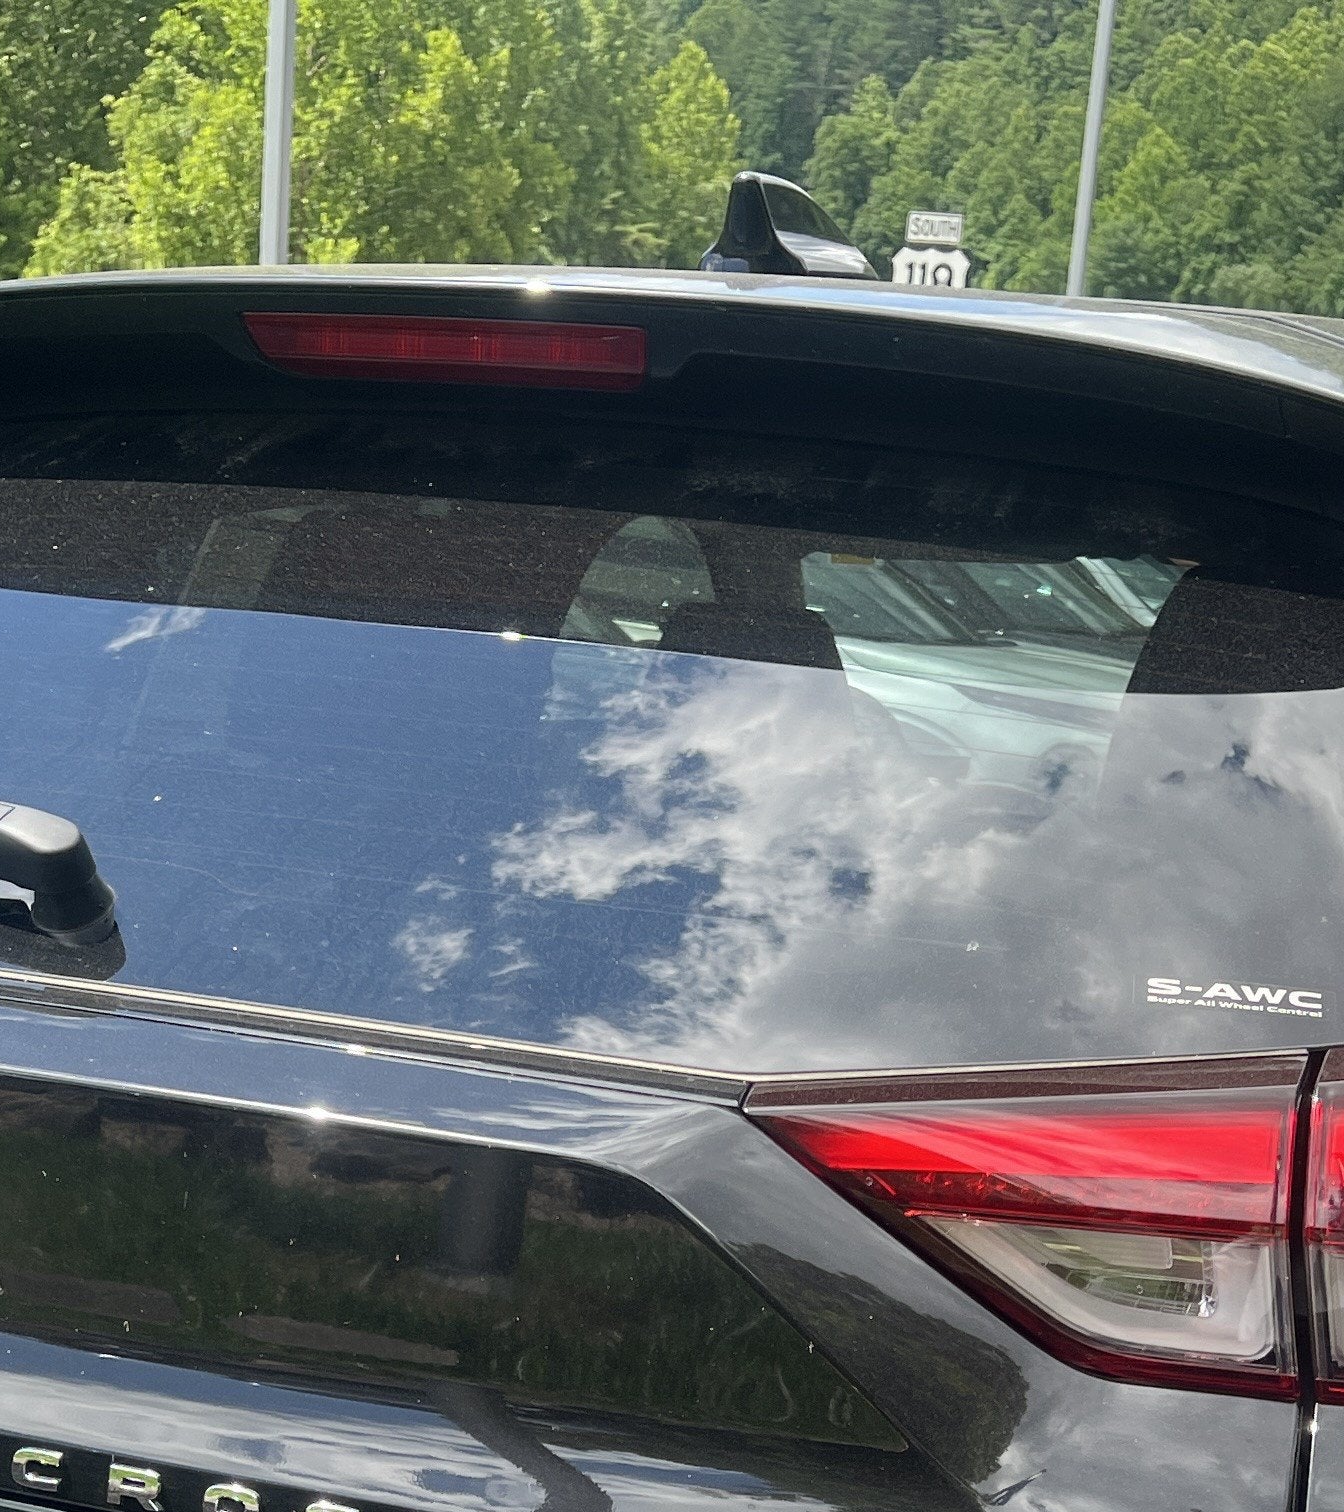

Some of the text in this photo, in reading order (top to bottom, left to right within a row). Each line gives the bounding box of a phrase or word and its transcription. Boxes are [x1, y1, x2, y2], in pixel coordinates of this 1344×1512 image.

[1147, 978, 1322, 1009] S-AWC
[1147, 995, 1323, 1018] Super All Wheel Control
